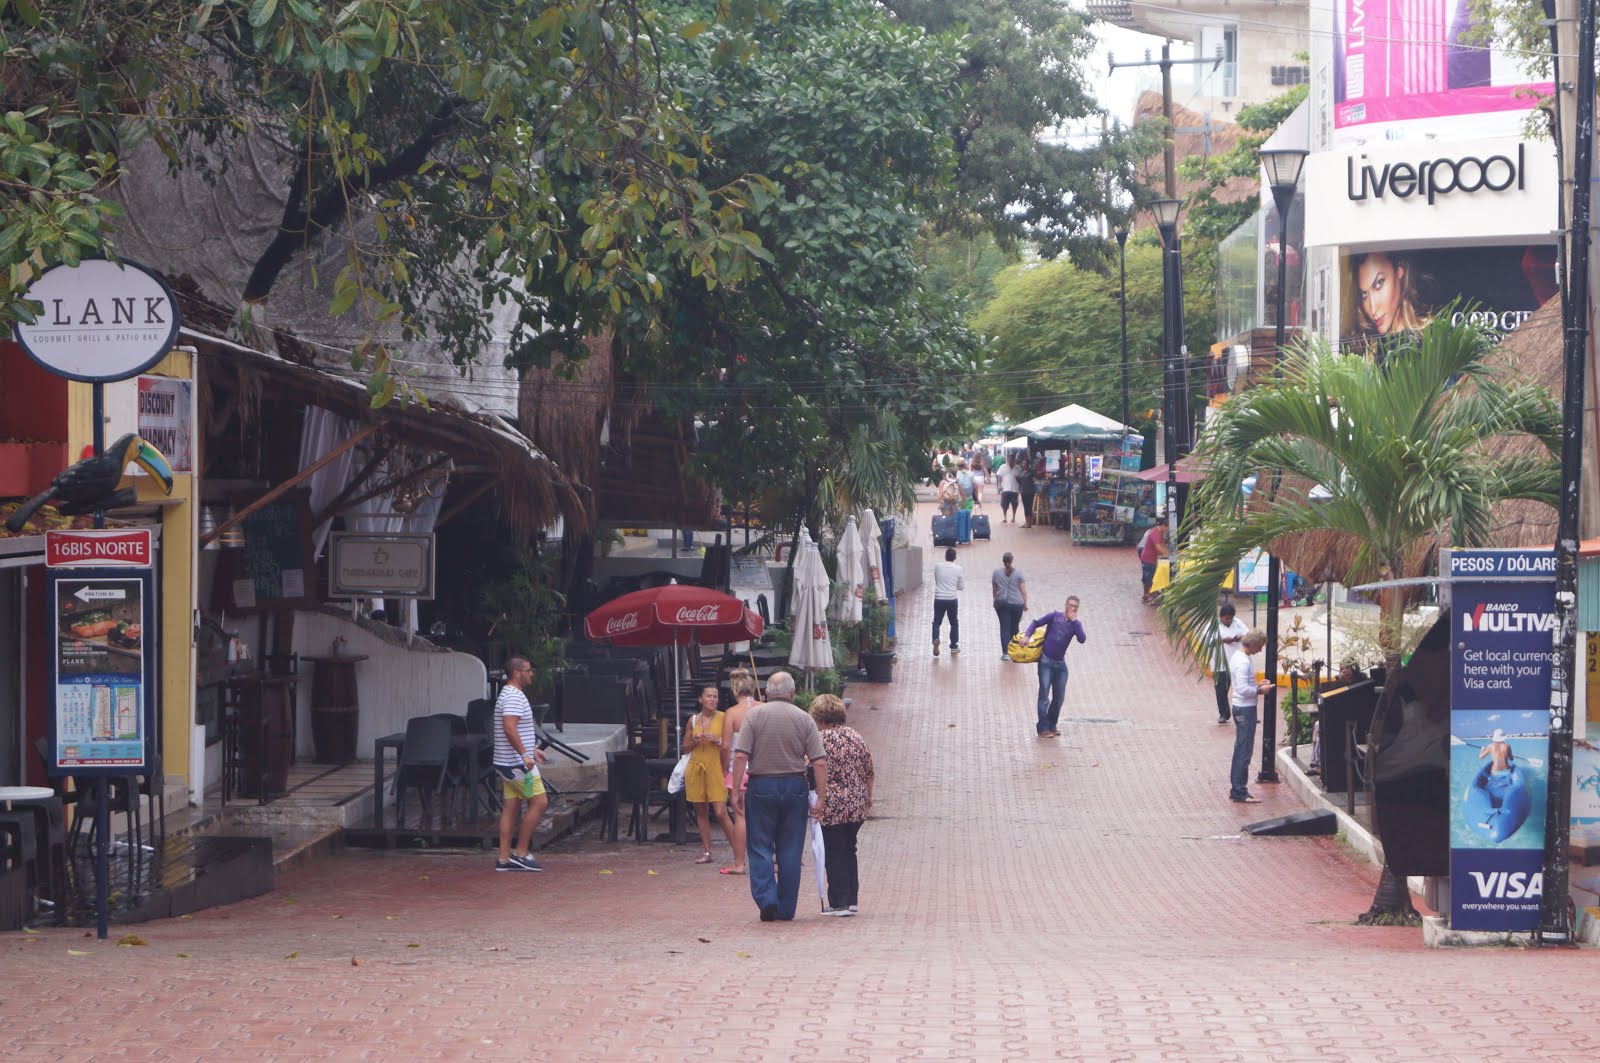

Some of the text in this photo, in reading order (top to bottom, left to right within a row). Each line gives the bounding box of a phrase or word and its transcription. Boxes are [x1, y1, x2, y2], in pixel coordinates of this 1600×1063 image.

[1348, 142, 1526, 205] Liverpool
[25, 297, 165, 326] LANK
[33, 335, 71, 343] GOURMET
[77, 334, 100, 342] GRILL
[140, 391, 175, 416] DISCOUNT
[54, 541, 144, 556] 16BIS NORTE
[1451, 557, 1495, 571] PESOS
[1497, 557, 1504, 571] /
[676, 604, 721, 622] Coca-Cola
[1485, 603, 1519, 611] BANCO
[1463, 604, 1556, 632] MULTIVA
[1463, 649, 1483, 661] Get
[1485, 649, 1511, 661] local
[1464, 663, 1488, 674] here
[1490, 663, 1515, 674] with
[1516, 666, 1541, 677] your
[1463, 677, 1512, 689] Visa card.
[1468, 872, 1543, 898] VISA
[1462, 902, 1505, 911] everywhere
